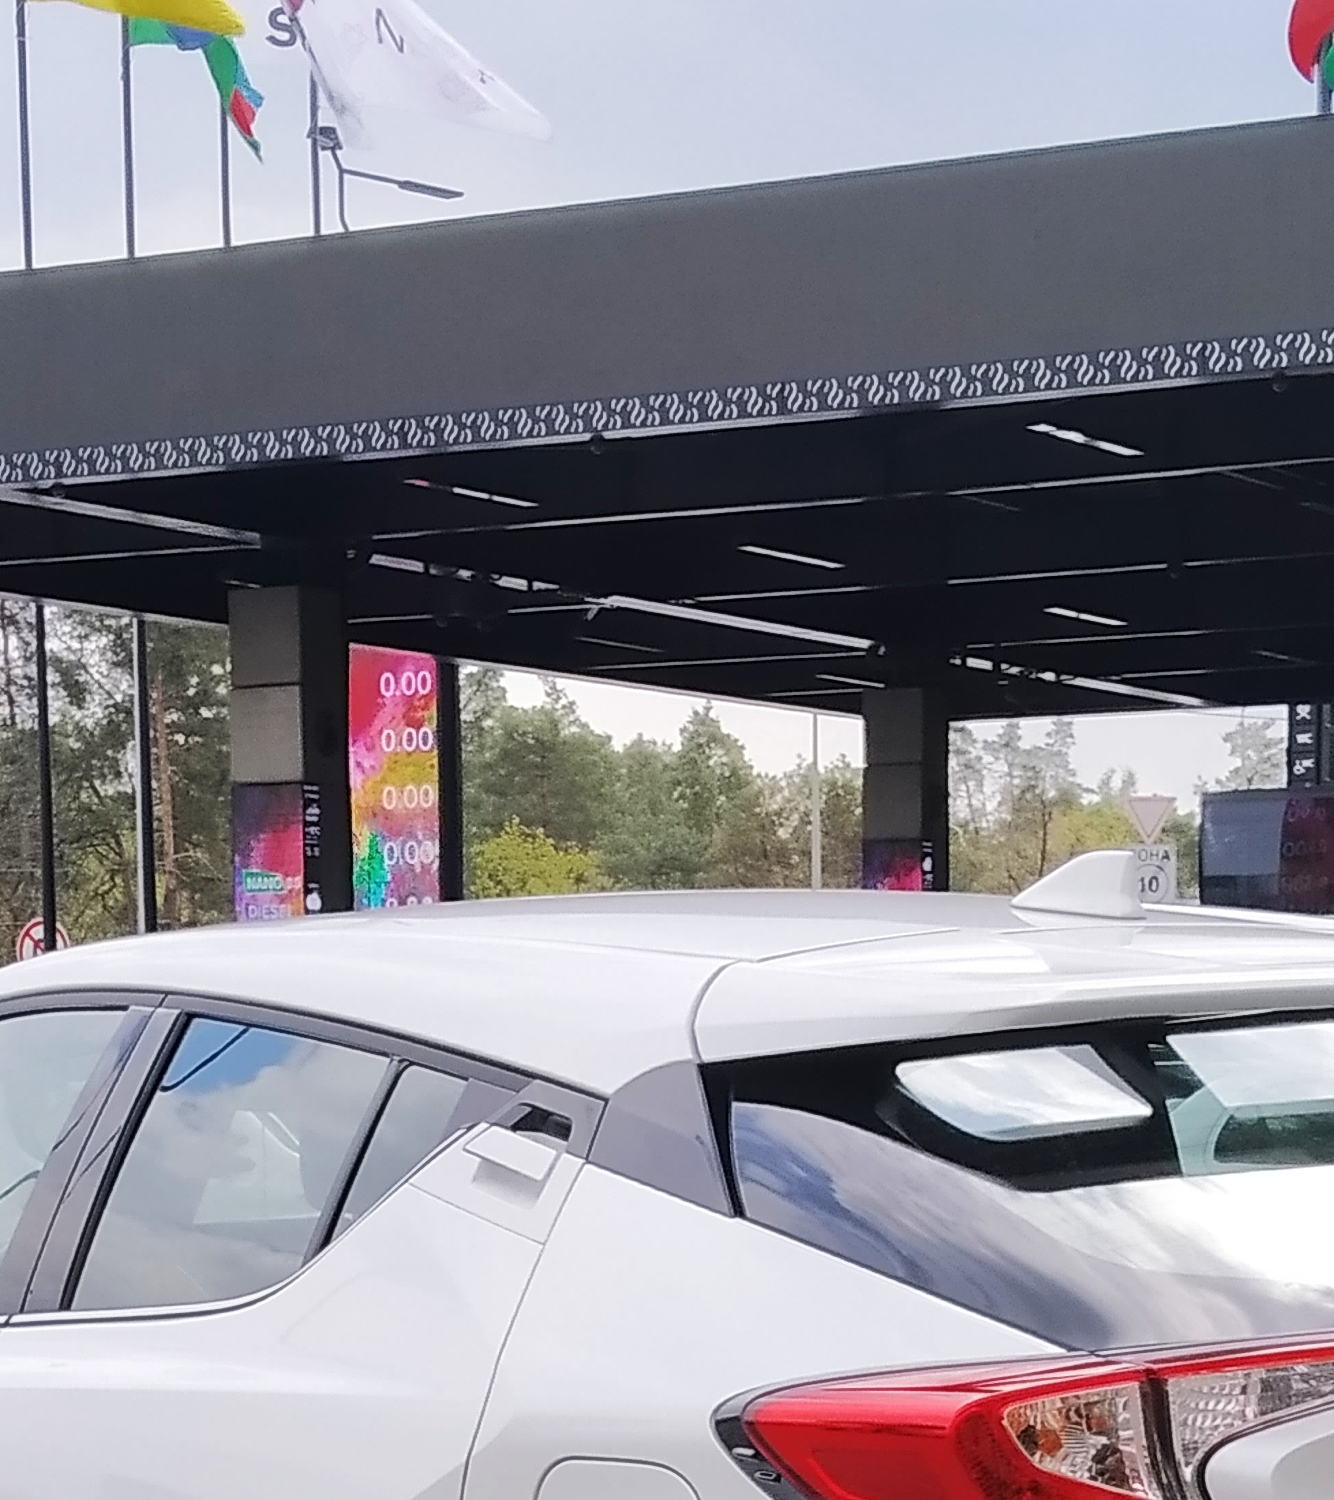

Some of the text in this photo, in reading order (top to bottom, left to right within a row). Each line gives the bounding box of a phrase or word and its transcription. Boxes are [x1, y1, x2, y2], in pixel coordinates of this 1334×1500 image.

[380, 671, 432, 697] 0.00
[381, 727, 433, 751] 0.00
[382, 785, 433, 810] 0.00
[1135, 848, 1171, 862] ОНА
[246, 876, 282, 890] NANO
[1140, 876, 1160, 893] 10
